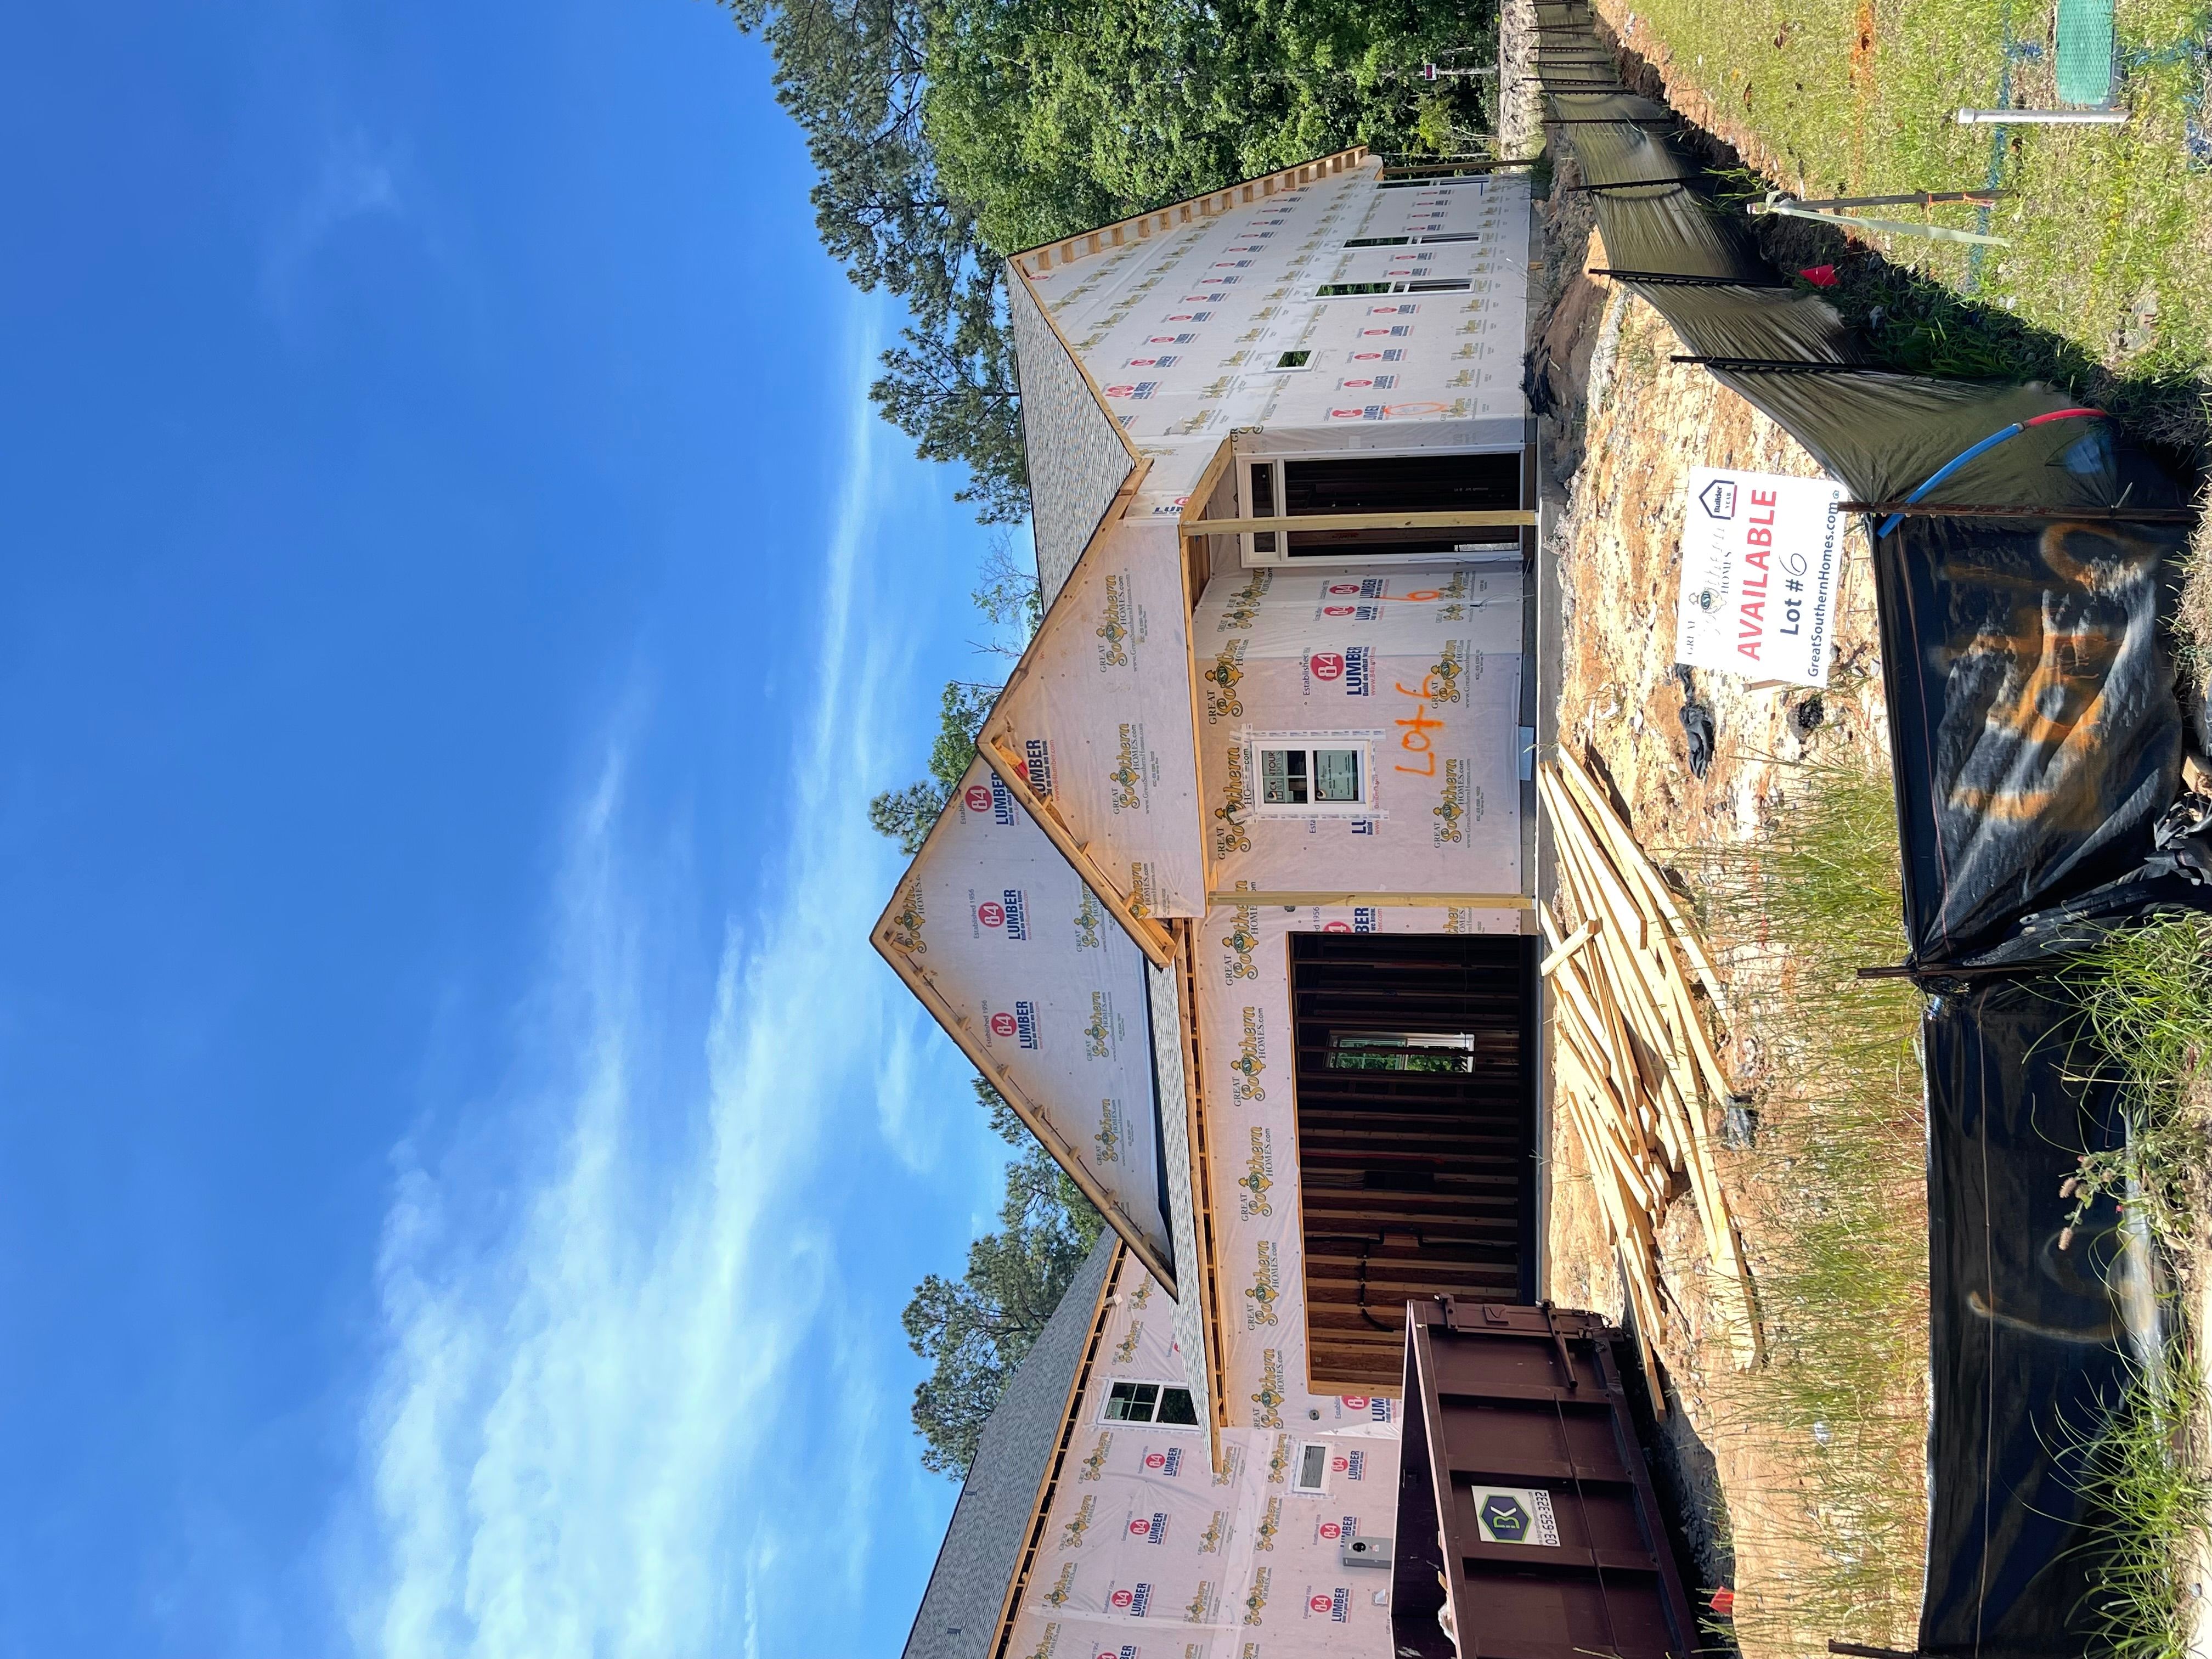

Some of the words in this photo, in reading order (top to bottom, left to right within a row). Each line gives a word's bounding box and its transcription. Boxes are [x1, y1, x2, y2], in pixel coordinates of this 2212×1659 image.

[1714, 486, 1723, 513] Builder
[1737, 490, 1777, 661] AVAILABLE
[1808, 502, 1839, 677] GreatSouthernHomes.com
[1118, 575, 1127, 625] HOMES.com
[1780, 599, 1802, 635] Lot
[1096, 574, 1127, 667] Southern
[1125, 574, 1137, 672] www.GreatSouthernHomes.com
[1098, 644, 1107, 673] GREAT
[1318, 654, 1337, 677] 84
[1345, 647, 1362, 695] LUMBER
[1395, 674, 1434, 698] 6
[1207, 690, 1217, 724] GREAT
[1131, 724, 1139, 770] HOMES.com
[1109, 723, 1141, 809] Southern
[958, 799, 967, 824] Establis
[970, 789, 988, 809] 84
[1111, 787, 1120, 815] GREAT
[1433, 759, 1464, 843] Southern
[1216, 827, 1226, 860] GREAT
[1143, 863, 1152, 905] HOMES.com
[971, 905, 980, 939] Established
[983, 905, 1000, 924] 84
[1003, 889, 1020, 939] LUMBER
[1222, 880, 1259, 980] Southen
[1354, 908, 1369, 933] BER
[1223, 954, 1233, 986] GREAT
[984, 1015, 992, 1047] Established
[996, 1015, 1012, 1034] 84
[1015, 1001, 1032, 1048] LUMBER
[1084, 991, 1109, 1058] Southern
[1257, 1007, 1266, 1059] HOMES.com
[1231, 1006, 1266, 1101] Southern
[1232, 1076, 1242, 1107] GREAT
[1094, 1099, 1118, 1162] Southern
[1265, 1128, 1273, 1176] HOMES.com
[1239, 1126, 1273, 1217] Southern
[1240, 1193, 1249, 1221] GREAT
[1271, 1242, 1279, 1288] HOMES.com
[1246, 1240, 1279, 1326] Southern
[1246, 1303, 1256, 1330] GREAT
[1251, 1348, 1284, 1429] Southern
[1276, 1350, 1284, 1393] HOMES.com
[1372, 1398, 1385, 1421] LUM
[1149, 1454, 1162, 1466] 84
[1163, 1448, 1178, 1476] LUMBER
[1348, 1451, 1359, 1480] LUMBER
[1133, 1521, 1147, 1533] 84
[1148, 1513, 1163, 1544] LUMBER
[1324, 1525, 1337, 1537] 84
[1115, 1592, 1130, 1605] 84
[1130, 1583, 1147, 1617] LUMBER
[1243, 1567, 1267, 1626] Southern
[1314, 1597, 1328, 1611] 84
[1331, 1588, 1345, 1622] LUMBER
